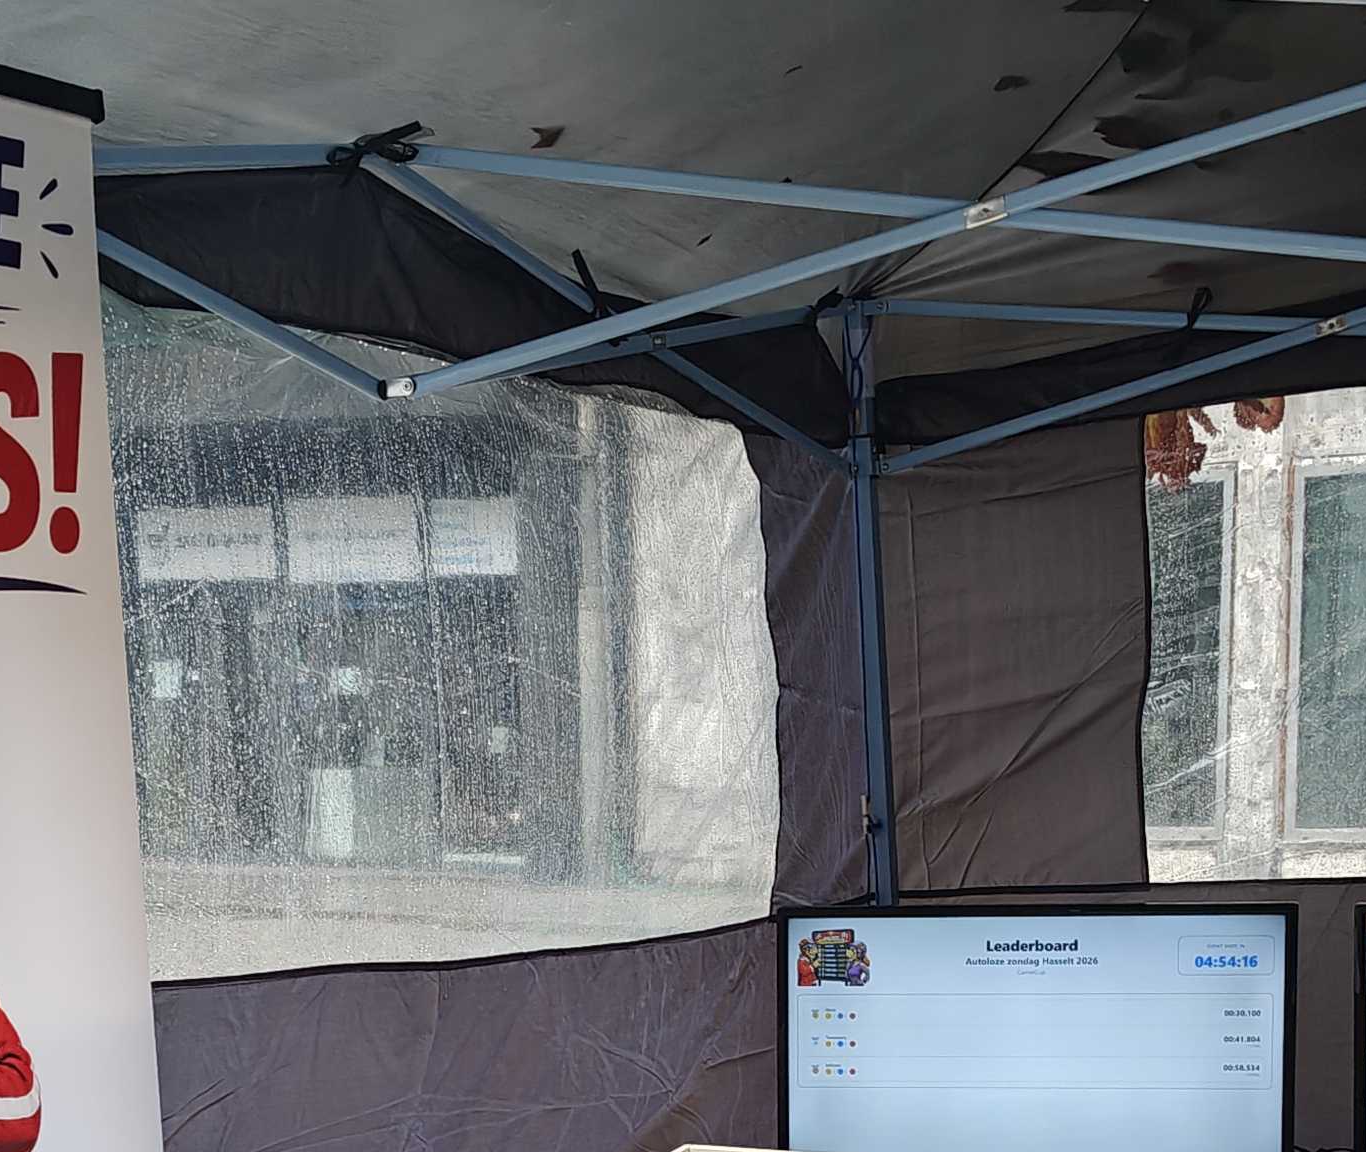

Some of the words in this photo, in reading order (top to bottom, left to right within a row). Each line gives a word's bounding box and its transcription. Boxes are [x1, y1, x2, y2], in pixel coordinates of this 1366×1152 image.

[986, 939, 1079, 952] Leaderboard
[965, 957, 1005, 966] Autoloze
[1007, 957, 1040, 967] zondag
[1042, 957, 1074, 966] Hasselt
[1076, 956, 1098, 966] 2026
[1195, 955, 1258, 968] 04:54:16
